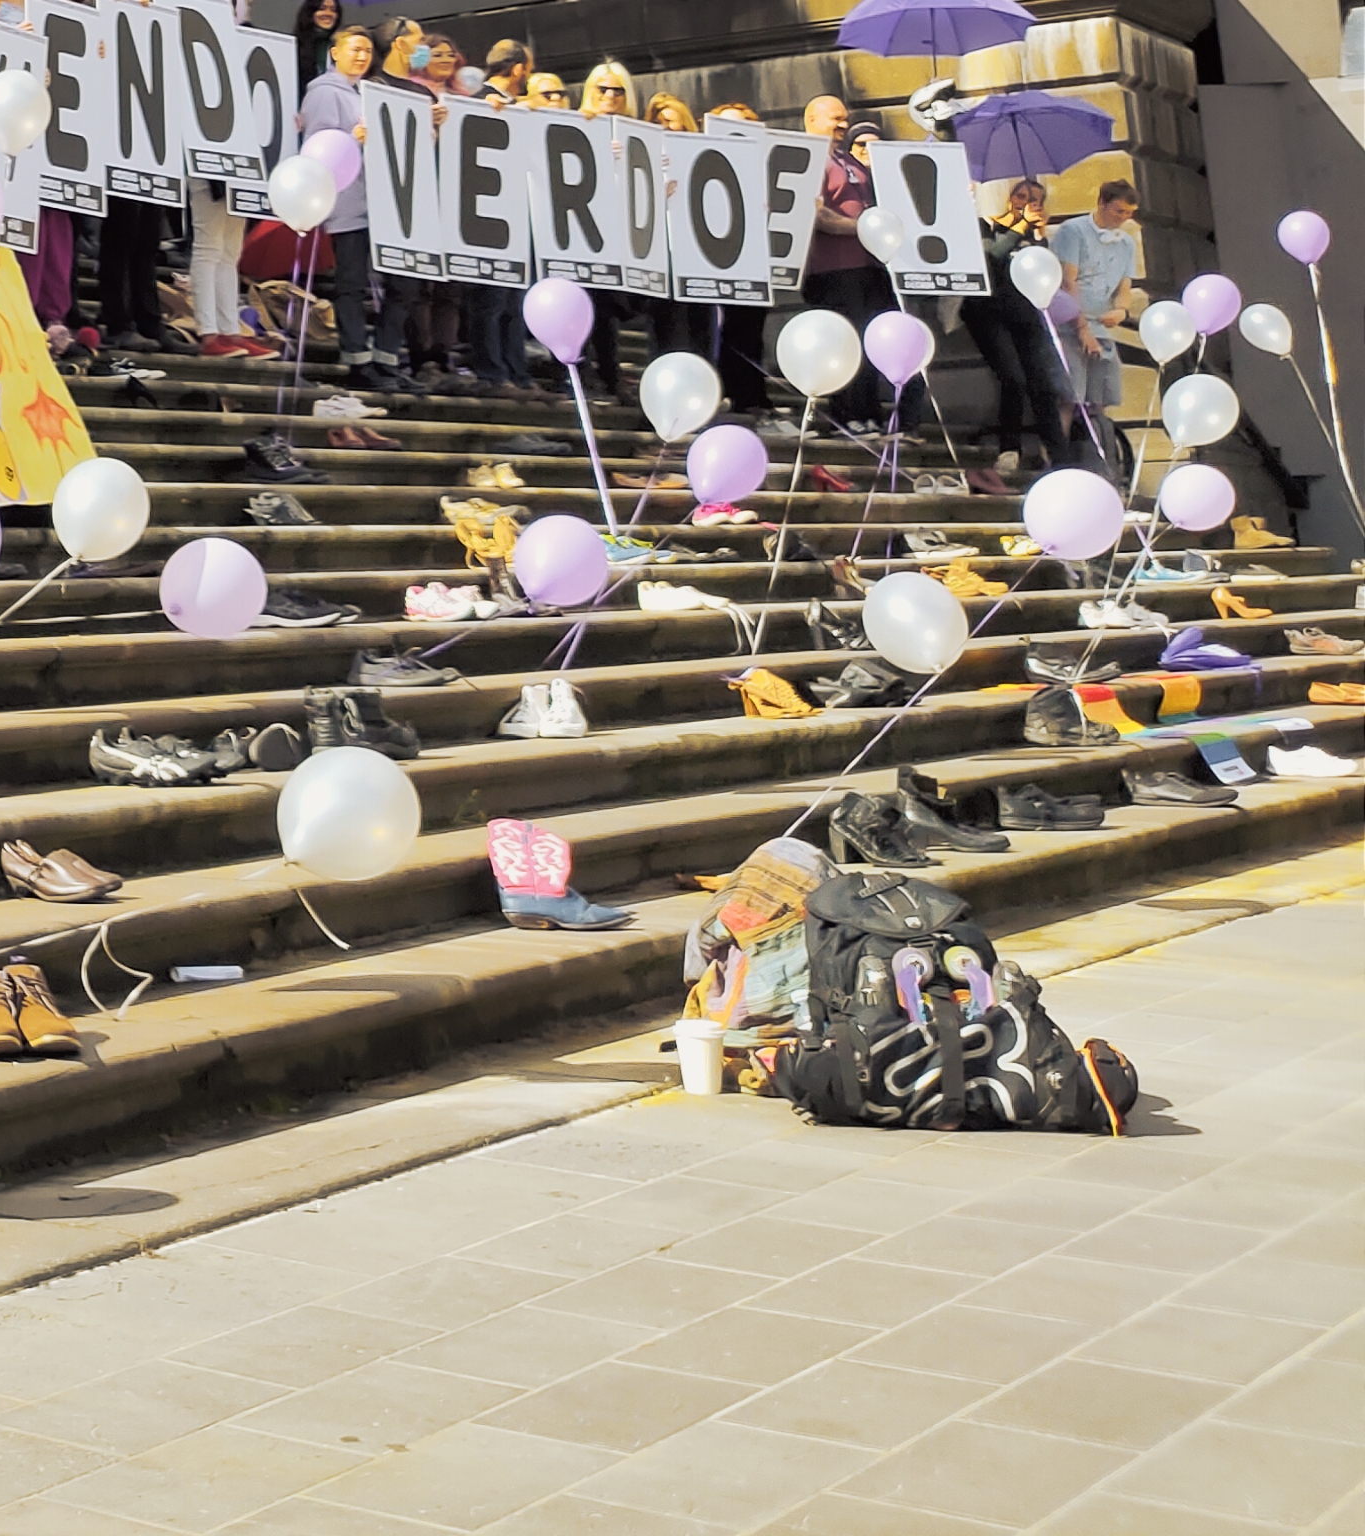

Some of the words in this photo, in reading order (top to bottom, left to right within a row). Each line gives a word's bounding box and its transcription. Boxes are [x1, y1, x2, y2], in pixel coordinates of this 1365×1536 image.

[44, 13, 89, 172] E
[117, 11, 166, 166] N
[176, 7, 235, 143] D
[379, 102, 416, 240] V
[460, 114, 510, 250] E
[546, 123, 604, 253] R
[627, 136, 655, 259] D
[689, 148, 746, 270] O
[767, 144, 811, 259] E
[899, 153, 949, 265] !
